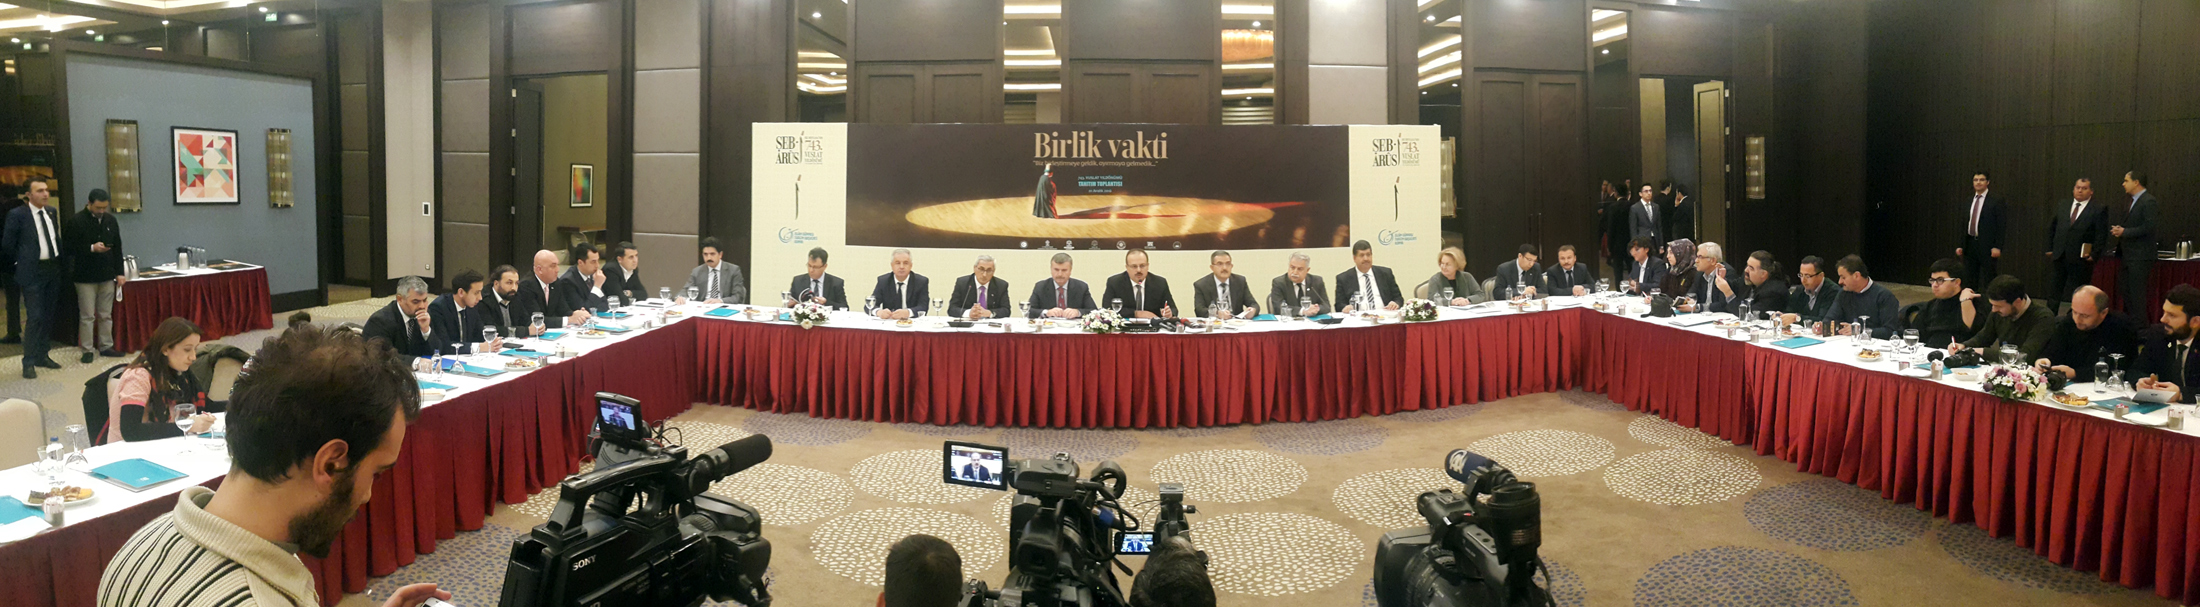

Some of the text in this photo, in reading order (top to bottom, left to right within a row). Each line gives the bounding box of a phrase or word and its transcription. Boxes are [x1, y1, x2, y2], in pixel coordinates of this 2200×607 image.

[1034, 131, 1169, 159] Birlik vakti
[573, 555, 596, 570] SONY
